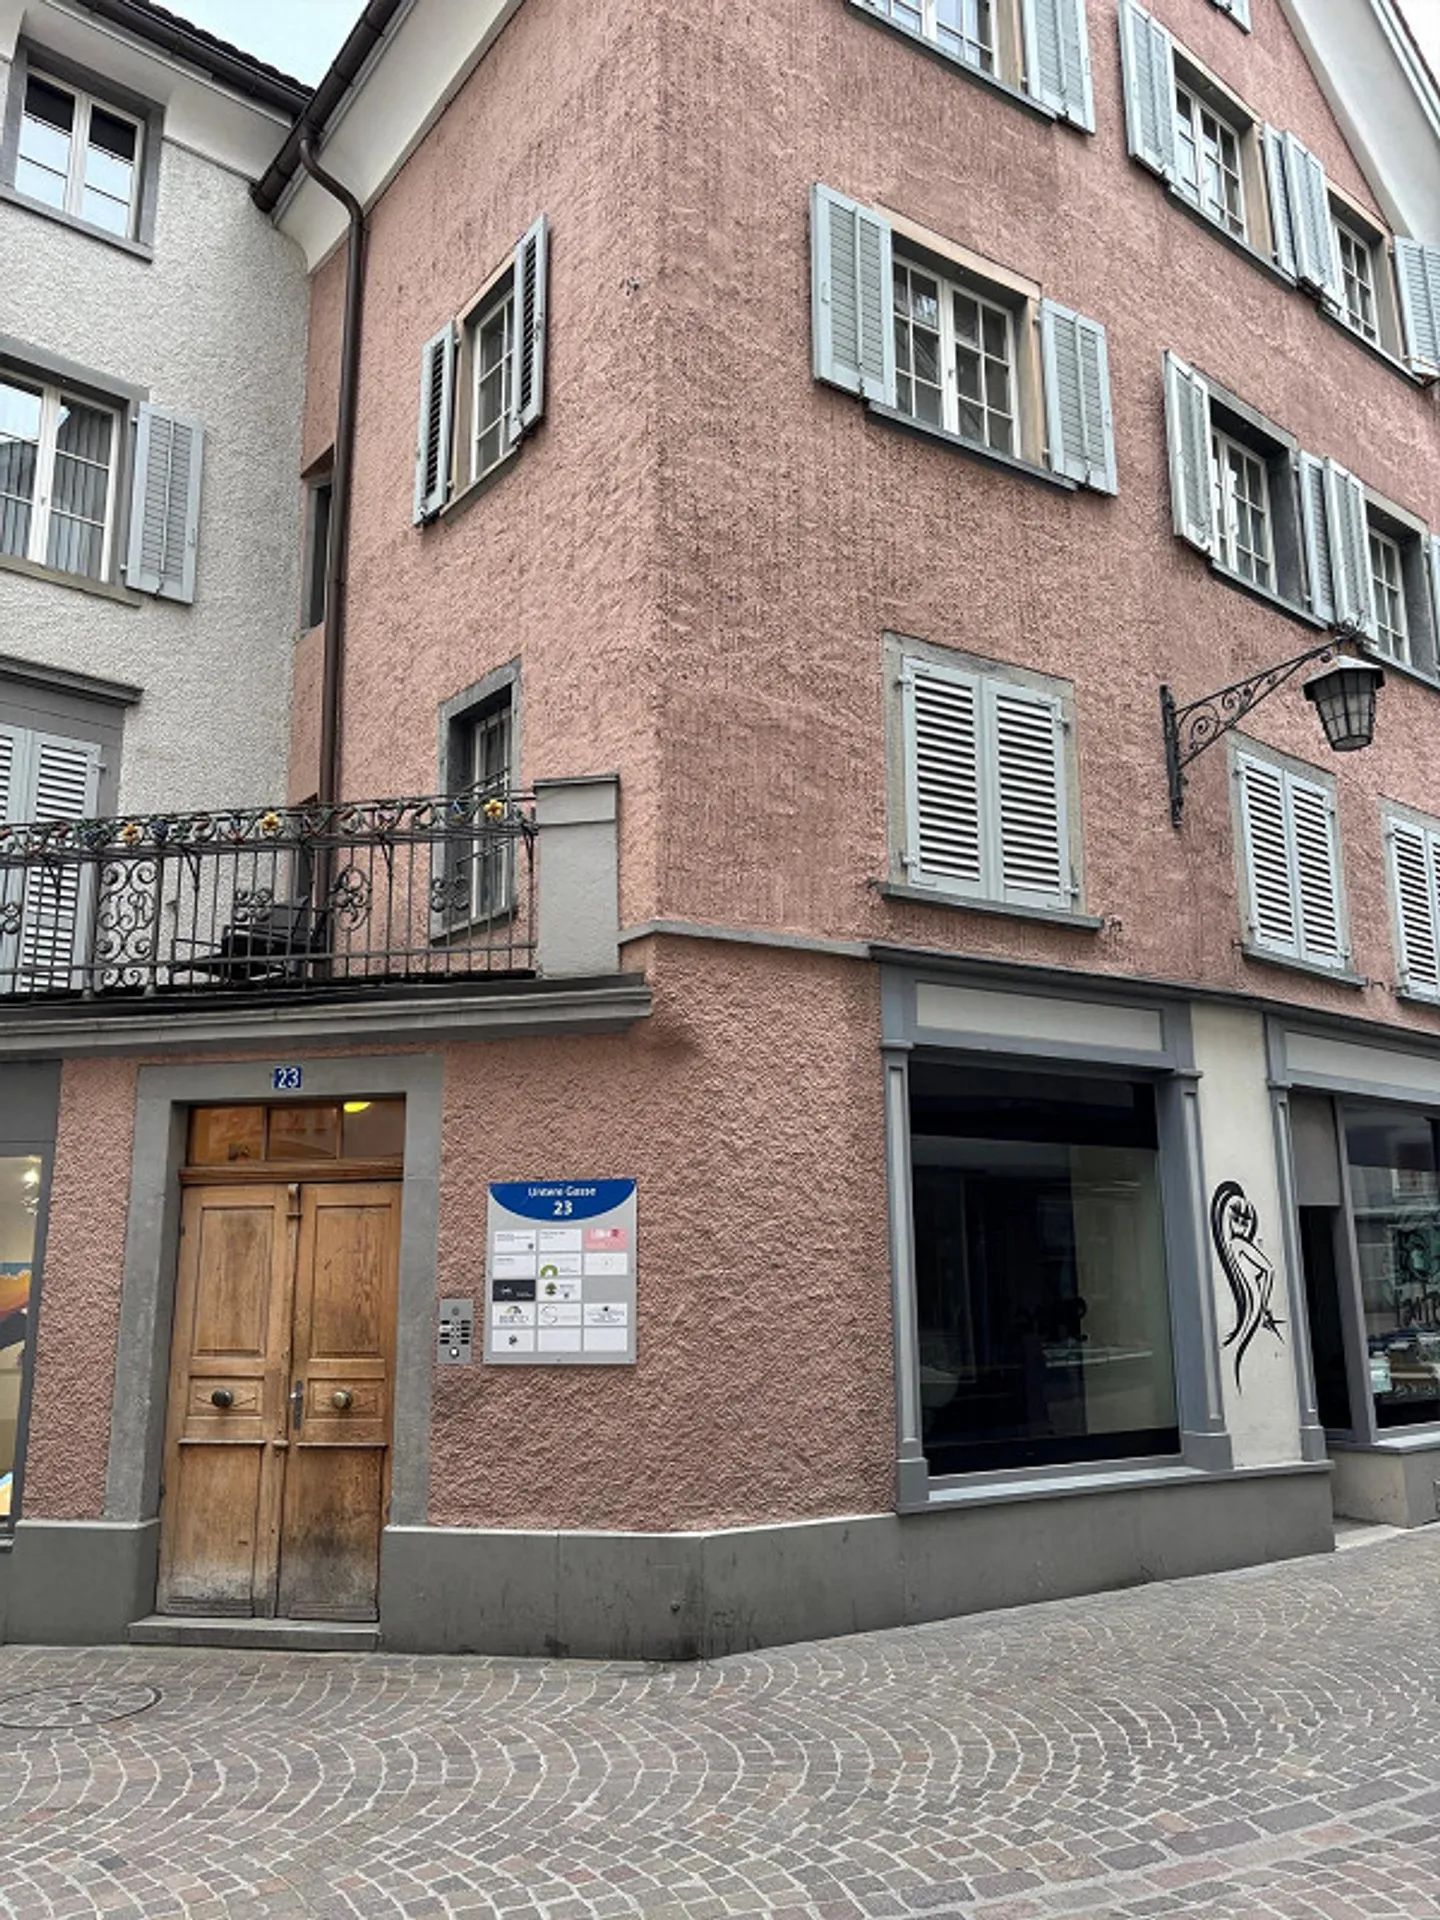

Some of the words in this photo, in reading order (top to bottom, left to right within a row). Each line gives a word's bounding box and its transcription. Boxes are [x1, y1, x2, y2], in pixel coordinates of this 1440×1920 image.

[278, 1068, 299, 1088] 23
[566, 1185, 596, 1197] Gasse
[553, 1199, 574, 1216] 23
